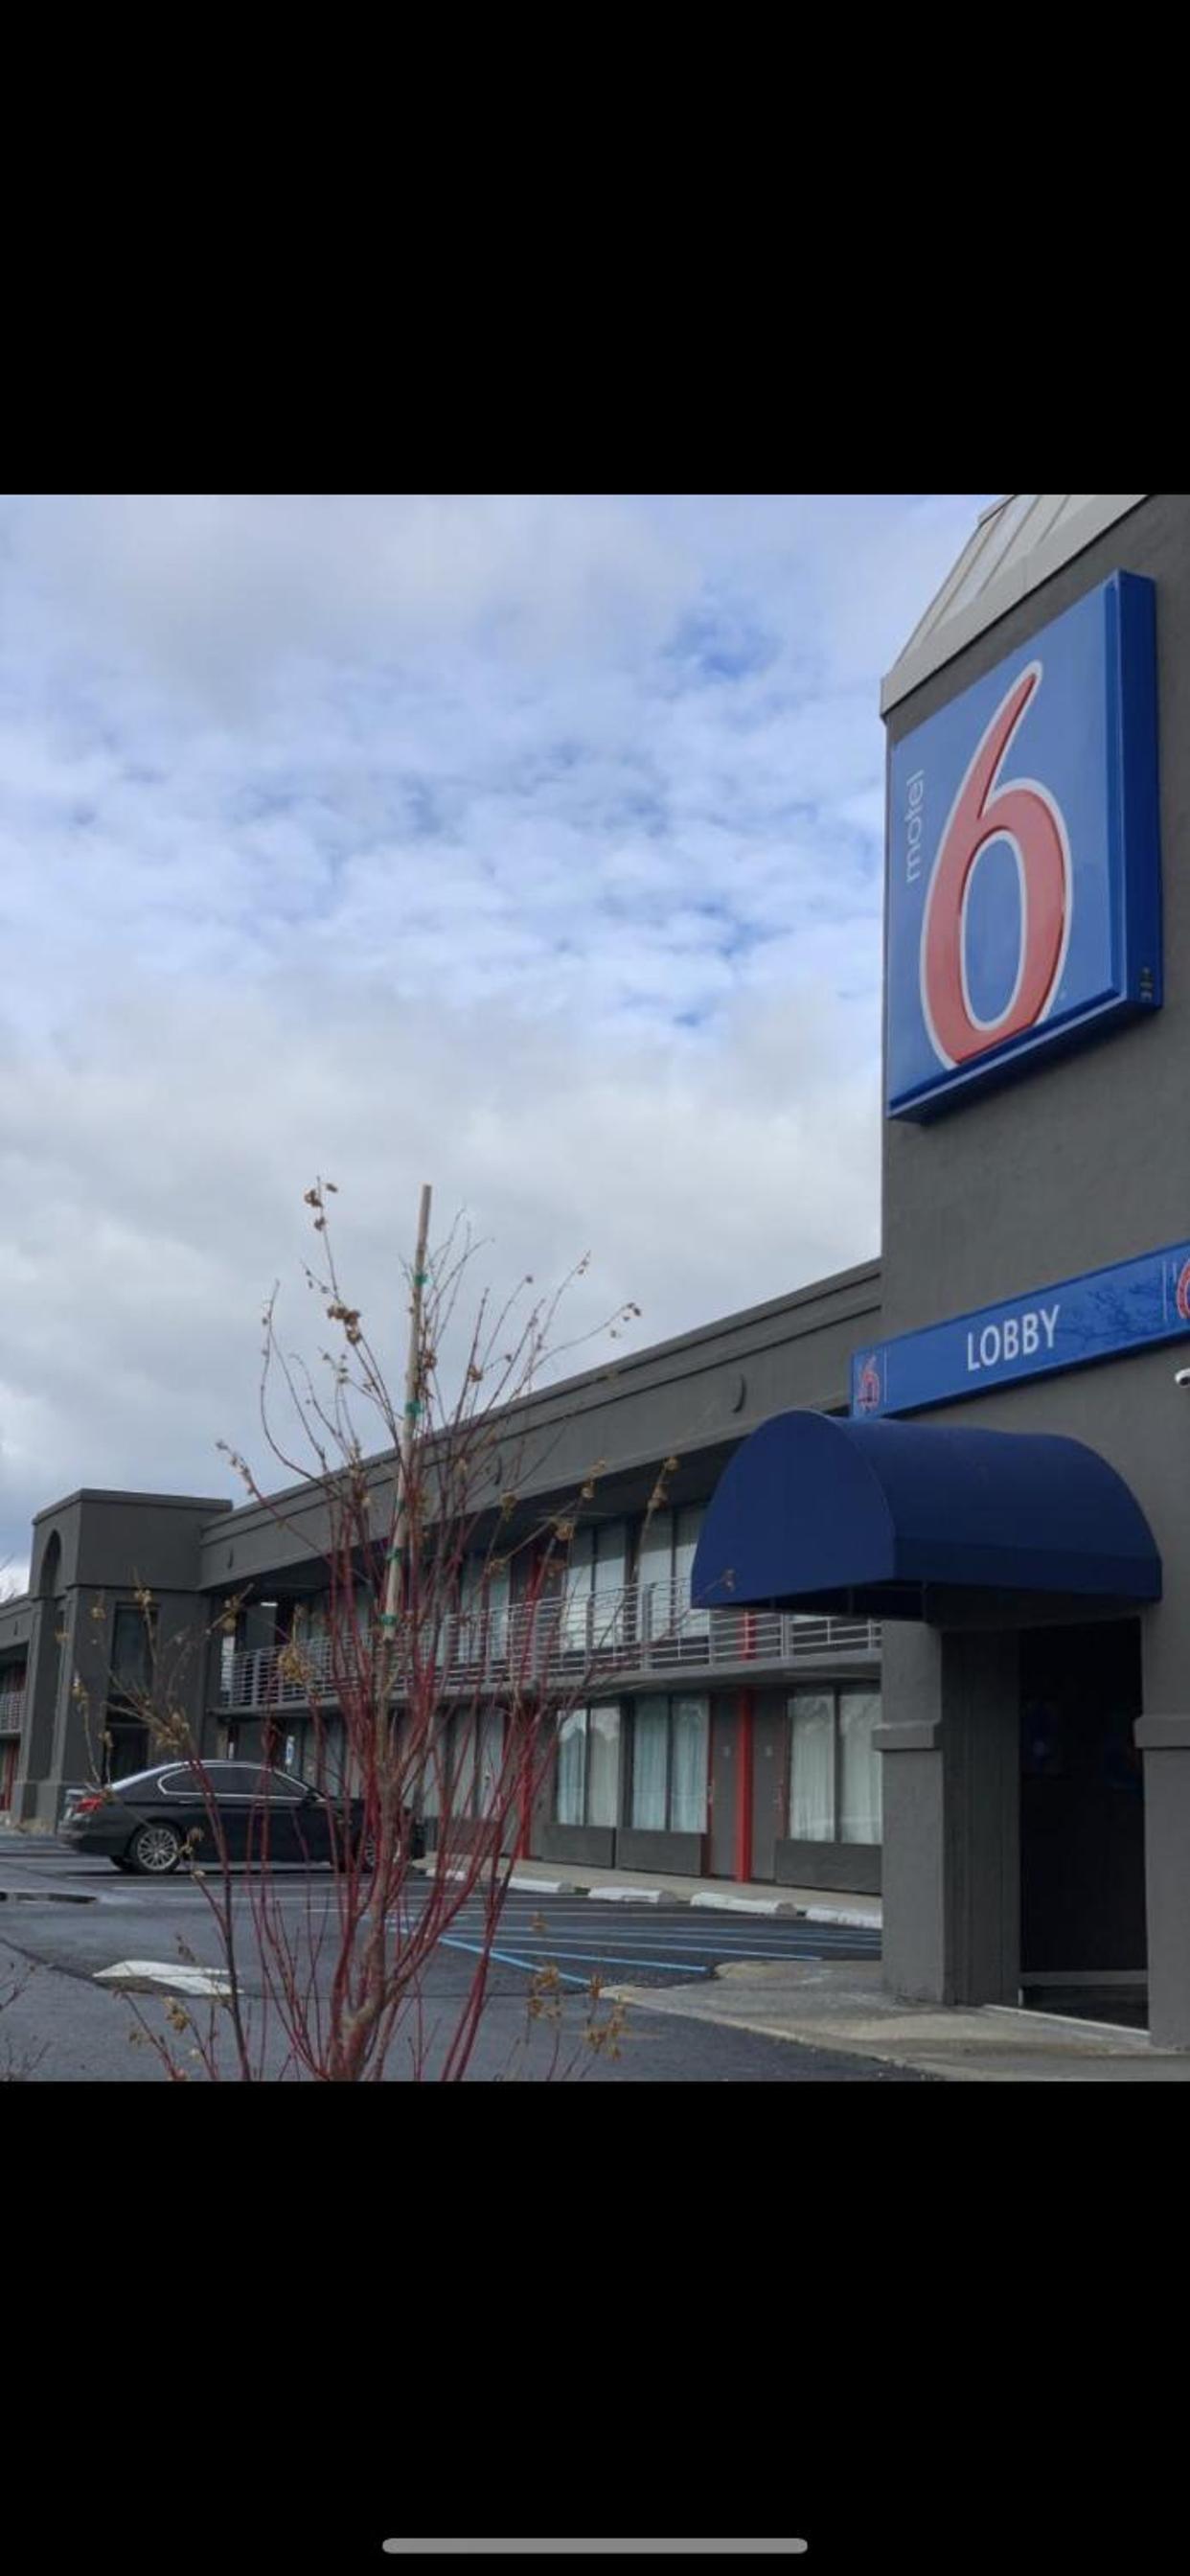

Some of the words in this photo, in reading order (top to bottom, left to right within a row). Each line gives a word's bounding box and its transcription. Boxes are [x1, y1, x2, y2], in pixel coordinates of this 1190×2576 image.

[906, 770, 924, 882] motel
[921, 660, 1072, 1070] 6
[967, 1305, 1060, 1371] LOBBY
